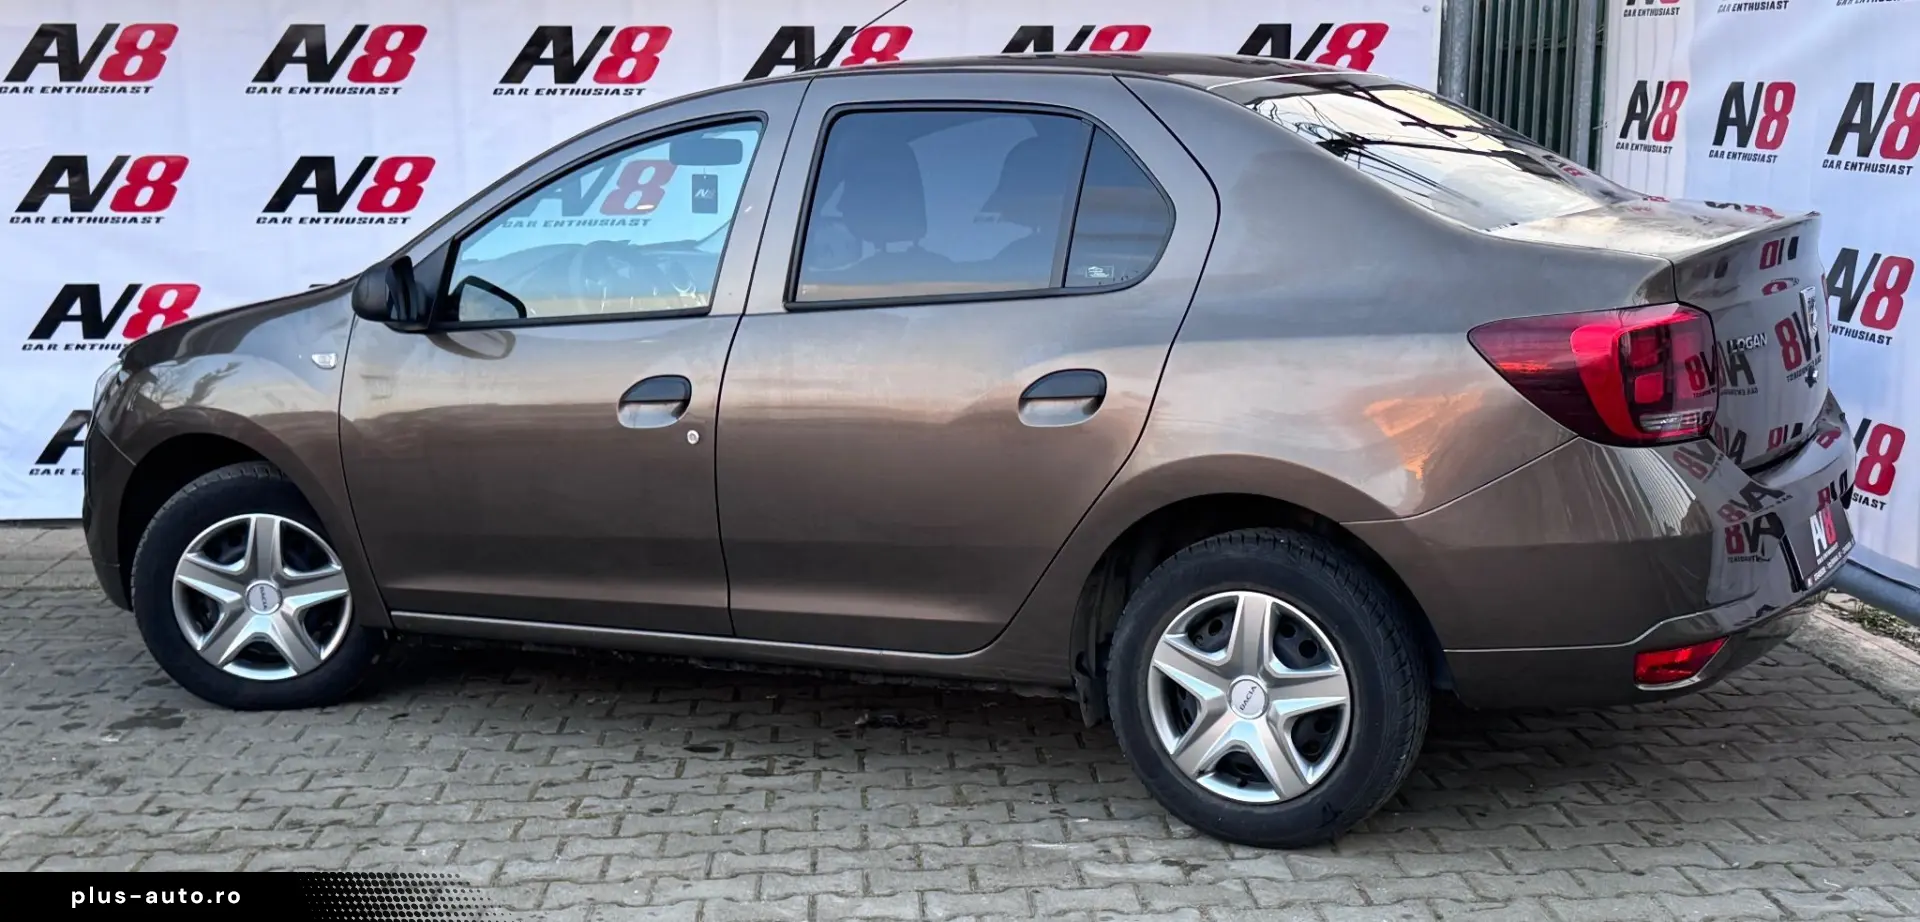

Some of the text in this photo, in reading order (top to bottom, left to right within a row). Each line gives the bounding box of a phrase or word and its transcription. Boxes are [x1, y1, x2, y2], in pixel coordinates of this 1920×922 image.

[1638, 7, 1680, 17] ENTHUSIAST
[1732, 0, 1790, 12] ENTHUSIAST
[3, 23, 179, 82] AV8
[252, 24, 428, 83] AV8
[499, 25, 673, 84] AV8
[40, 86, 154, 94] ENTHUSIAST
[245, 87, 402, 95] CAR ENTHUSIAST
[493, 88, 646, 96] CAR ENTHUSIAST
[1619, 80, 1689, 142] AV8
[1712, 81, 1796, 150] AV8
[1827, 82, 1920, 160] AV8
[1616, 142, 1673, 155] CAR ENTHUSIAST
[1709, 150, 1778, 164] CAR ENTHUSIAST
[1822, 159, 1913, 175] CAR ENTHUSIAST
[15, 155, 189, 212] AV8
[262, 156, 436, 213] AV8
[9, 216, 165, 224] CAR ENTHUSIAST
[256, 217, 411, 225] CAR ENTHUSIAST
[543, 218, 652, 228] ENTHUSIAST
[1826, 247, 1914, 331] AV8
[1829, 323, 1893, 346] NTHUSIAST
[22, 343, 57, 351] CAR
[1730, 332, 1768, 353] LOGAN
[29, 468, 65, 476] CAR
